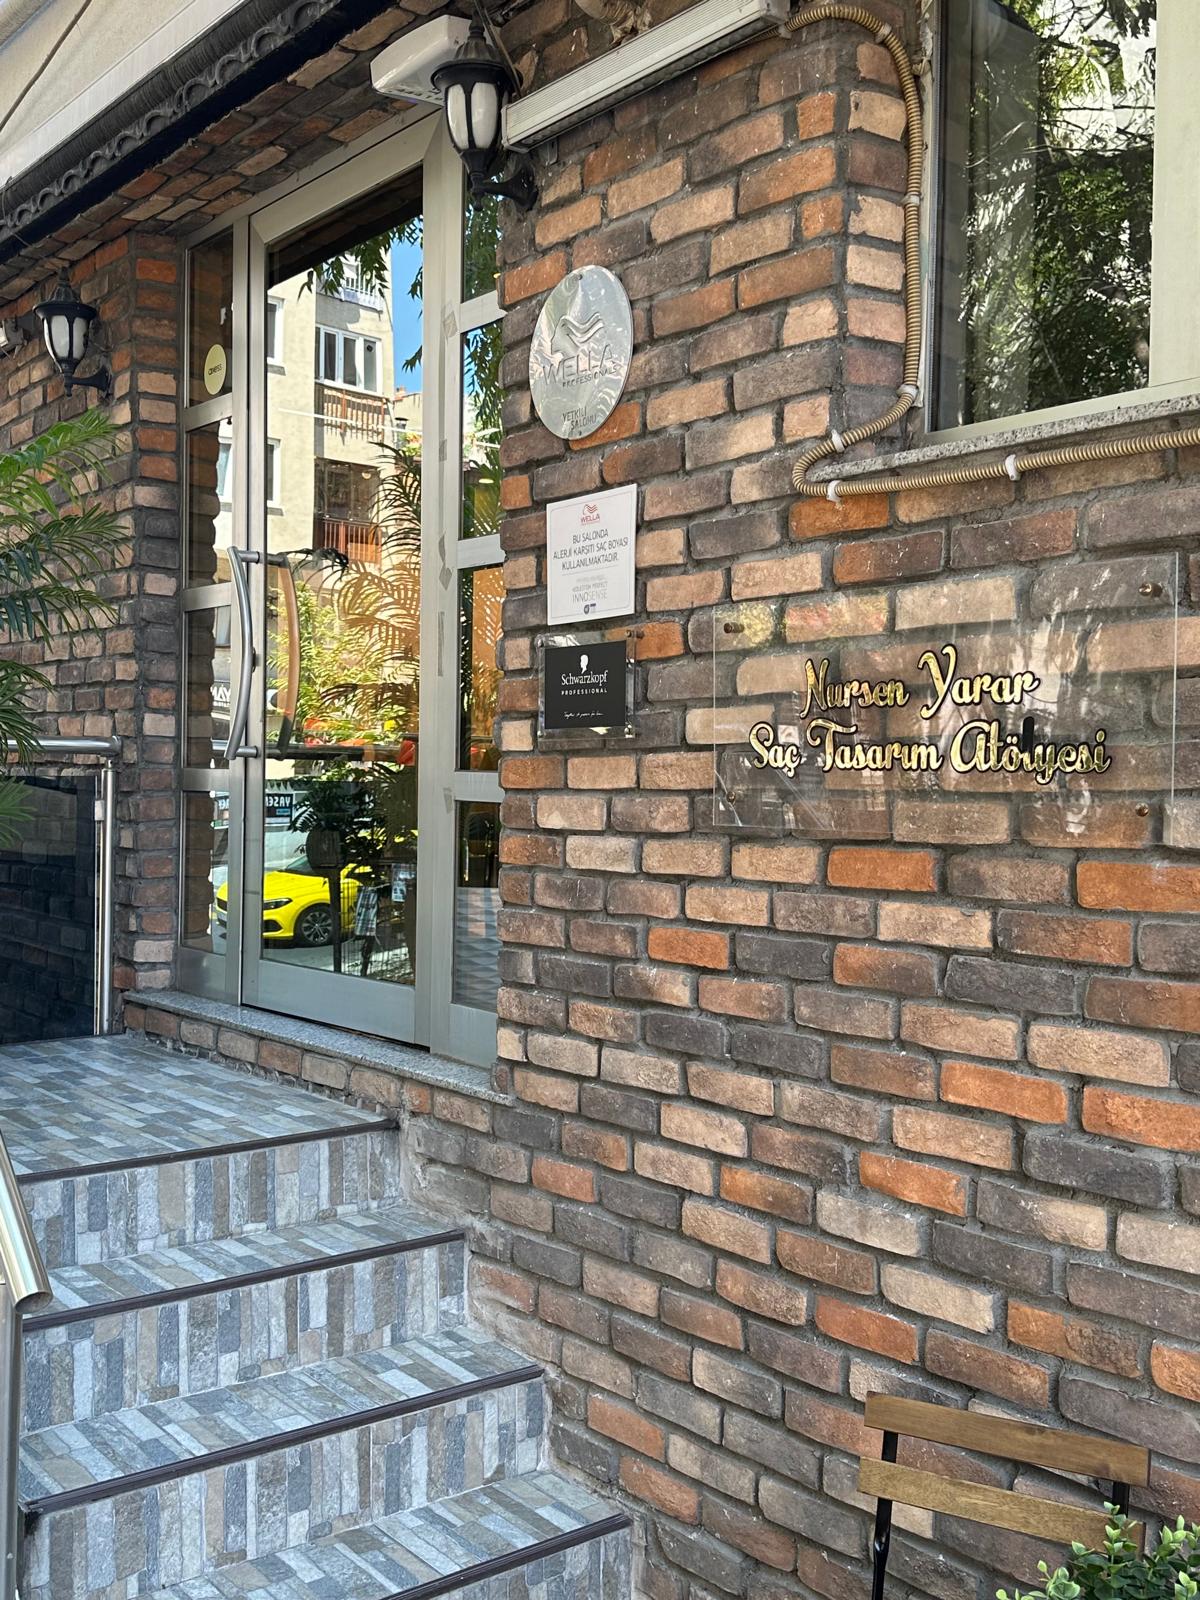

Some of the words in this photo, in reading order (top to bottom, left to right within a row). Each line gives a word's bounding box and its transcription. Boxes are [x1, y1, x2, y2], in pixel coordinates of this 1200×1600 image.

[542, 343, 614, 385] WELLA
[562, 366, 618, 388] PROFESSIONALS
[580, 513, 600, 523] WELLA
[572, 534, 581, 544] BU
[582, 529, 609, 541] SALONDA
[596, 541, 606, 553] SAÇ
[608, 536, 629, 550] BOYASI
[561, 670, 609, 686] Schwarzkopf
[800, 658, 909, 720] Nursen
[917, 643, 1039, 719] Yarar
[561, 687, 608, 696] PROFESSIONAL
[748, 721, 803, 778] Saç
[806, 718, 943, 774] Tasarım
[949, 716, 1112, 786] Atölyesi
